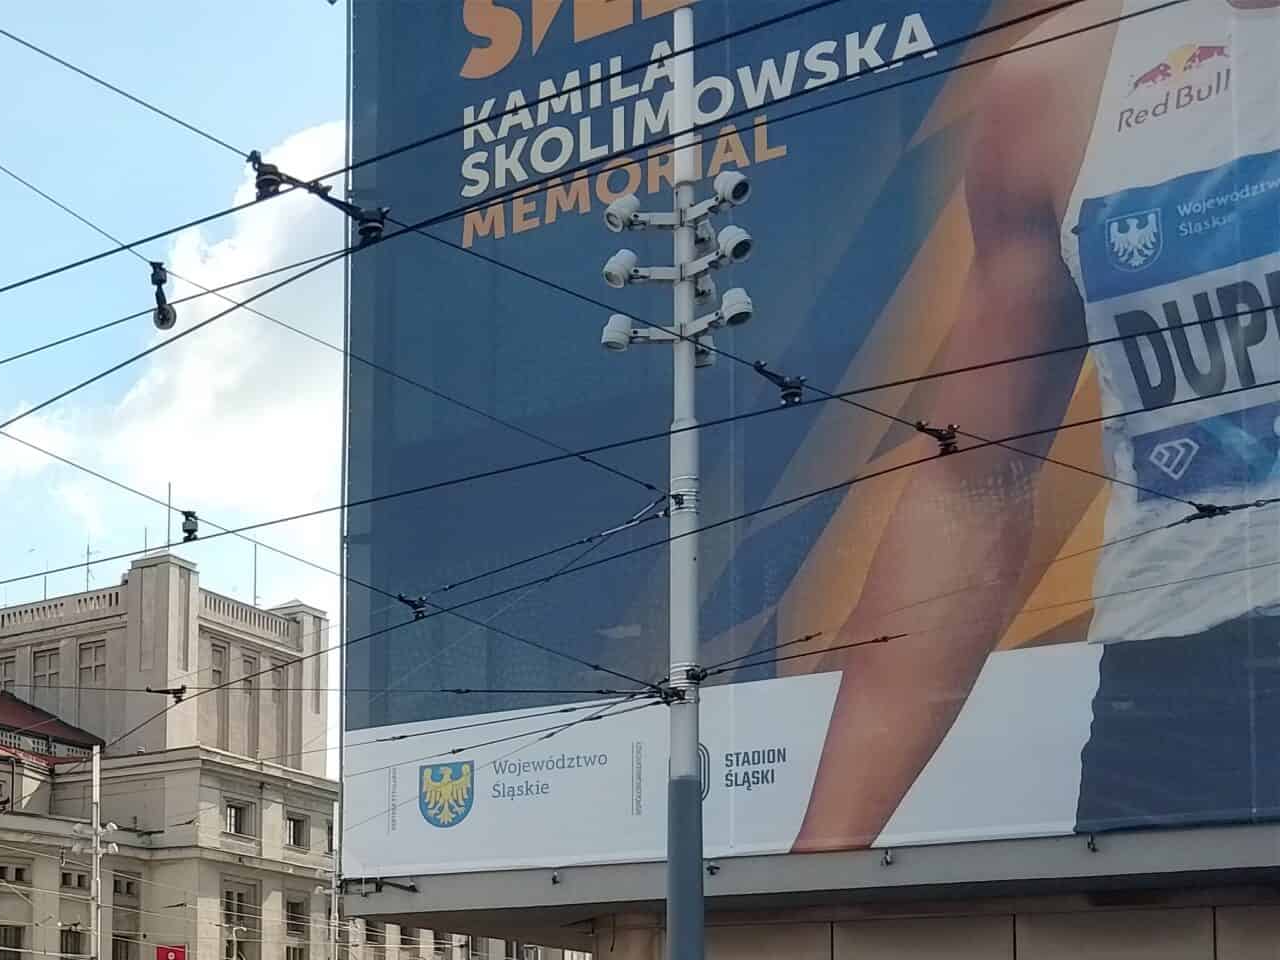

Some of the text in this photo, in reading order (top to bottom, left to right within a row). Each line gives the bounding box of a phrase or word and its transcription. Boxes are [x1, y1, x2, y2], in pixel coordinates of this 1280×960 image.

[461, 13, 938, 198] SKOLIMOWSKA
[463, 40, 677, 150] KAMILA
[1117, 68, 1231, 133] Red Bull
[462, 115, 787, 249] MEMORIAL
[489, 752, 609, 778] Województwo
[724, 747, 787, 768] STADION
[724, 768, 775, 791] ŚLĄSKI
[490, 779, 551, 799] Śląskie
